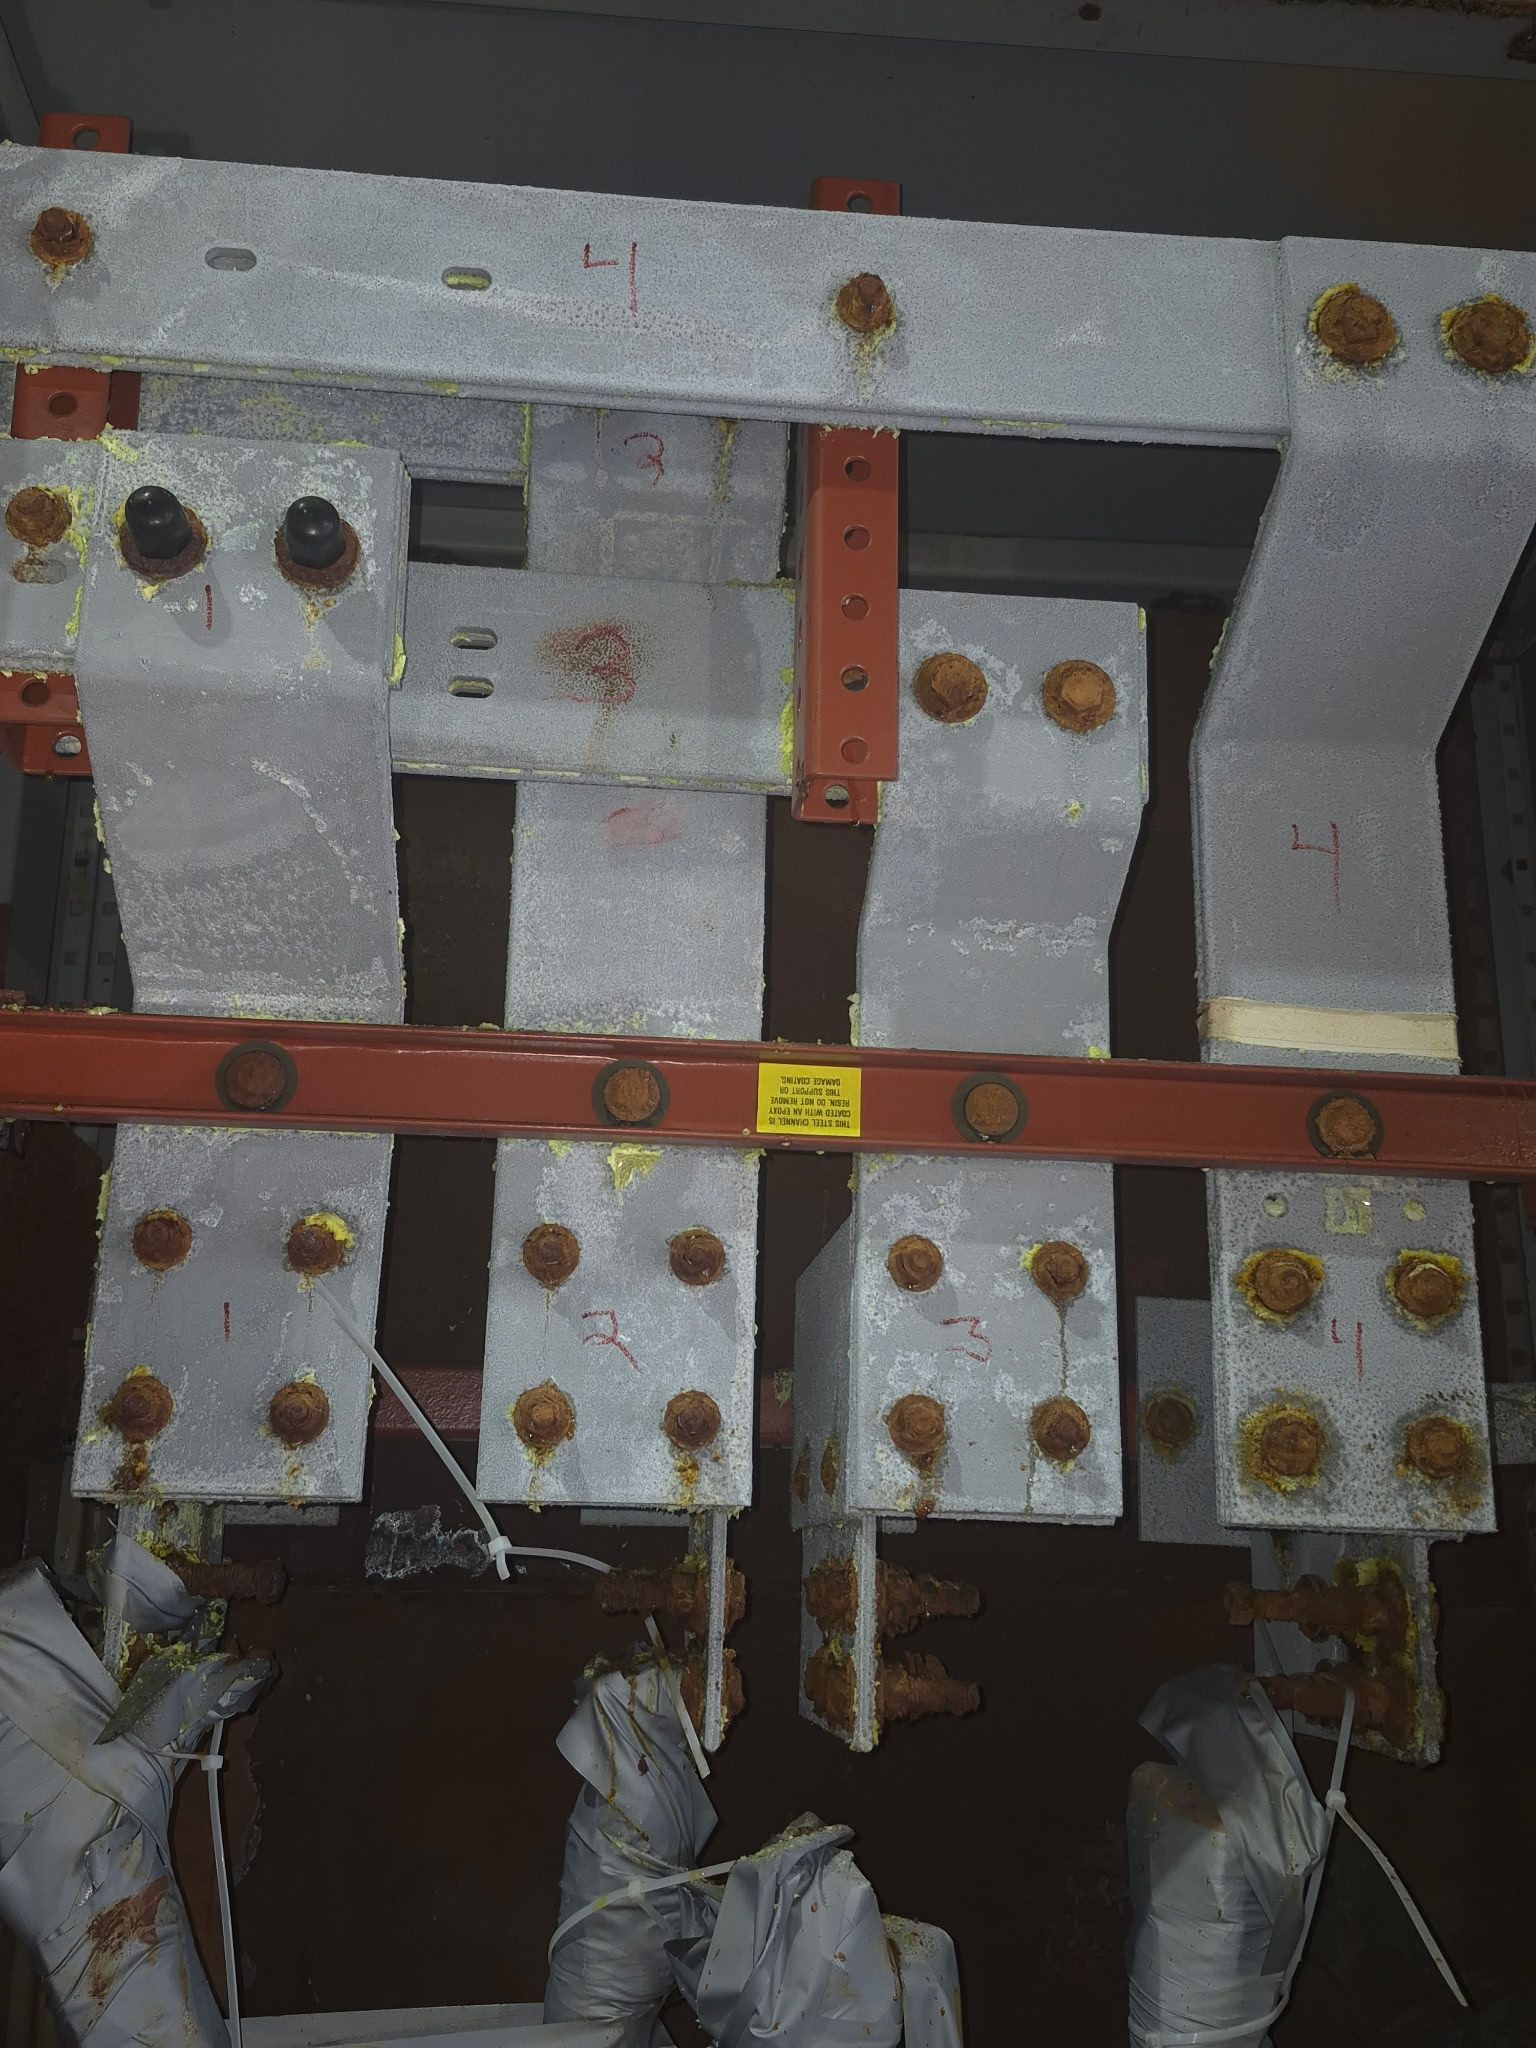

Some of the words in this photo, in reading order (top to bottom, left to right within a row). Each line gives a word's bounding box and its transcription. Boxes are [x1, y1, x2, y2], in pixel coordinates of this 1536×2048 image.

[583, 241, 638, 318] 4
[1291, 821, 1340, 912] 4
[813, 1078, 840, 1086] DAMAGE
[792, 1087, 823, 1095] SUPPORT
[770, 1097, 797, 1105] REMOVE
[769, 1107, 790, 1115] EPOXY
[826, 1109, 850, 1117] COATED
[779, 1118, 809, 1126] CHANNEL
[813, 1119, 832, 1127] STEEL
[835, 1120, 850, 1128] THIS
[941, 1316, 992, 1366] 3
